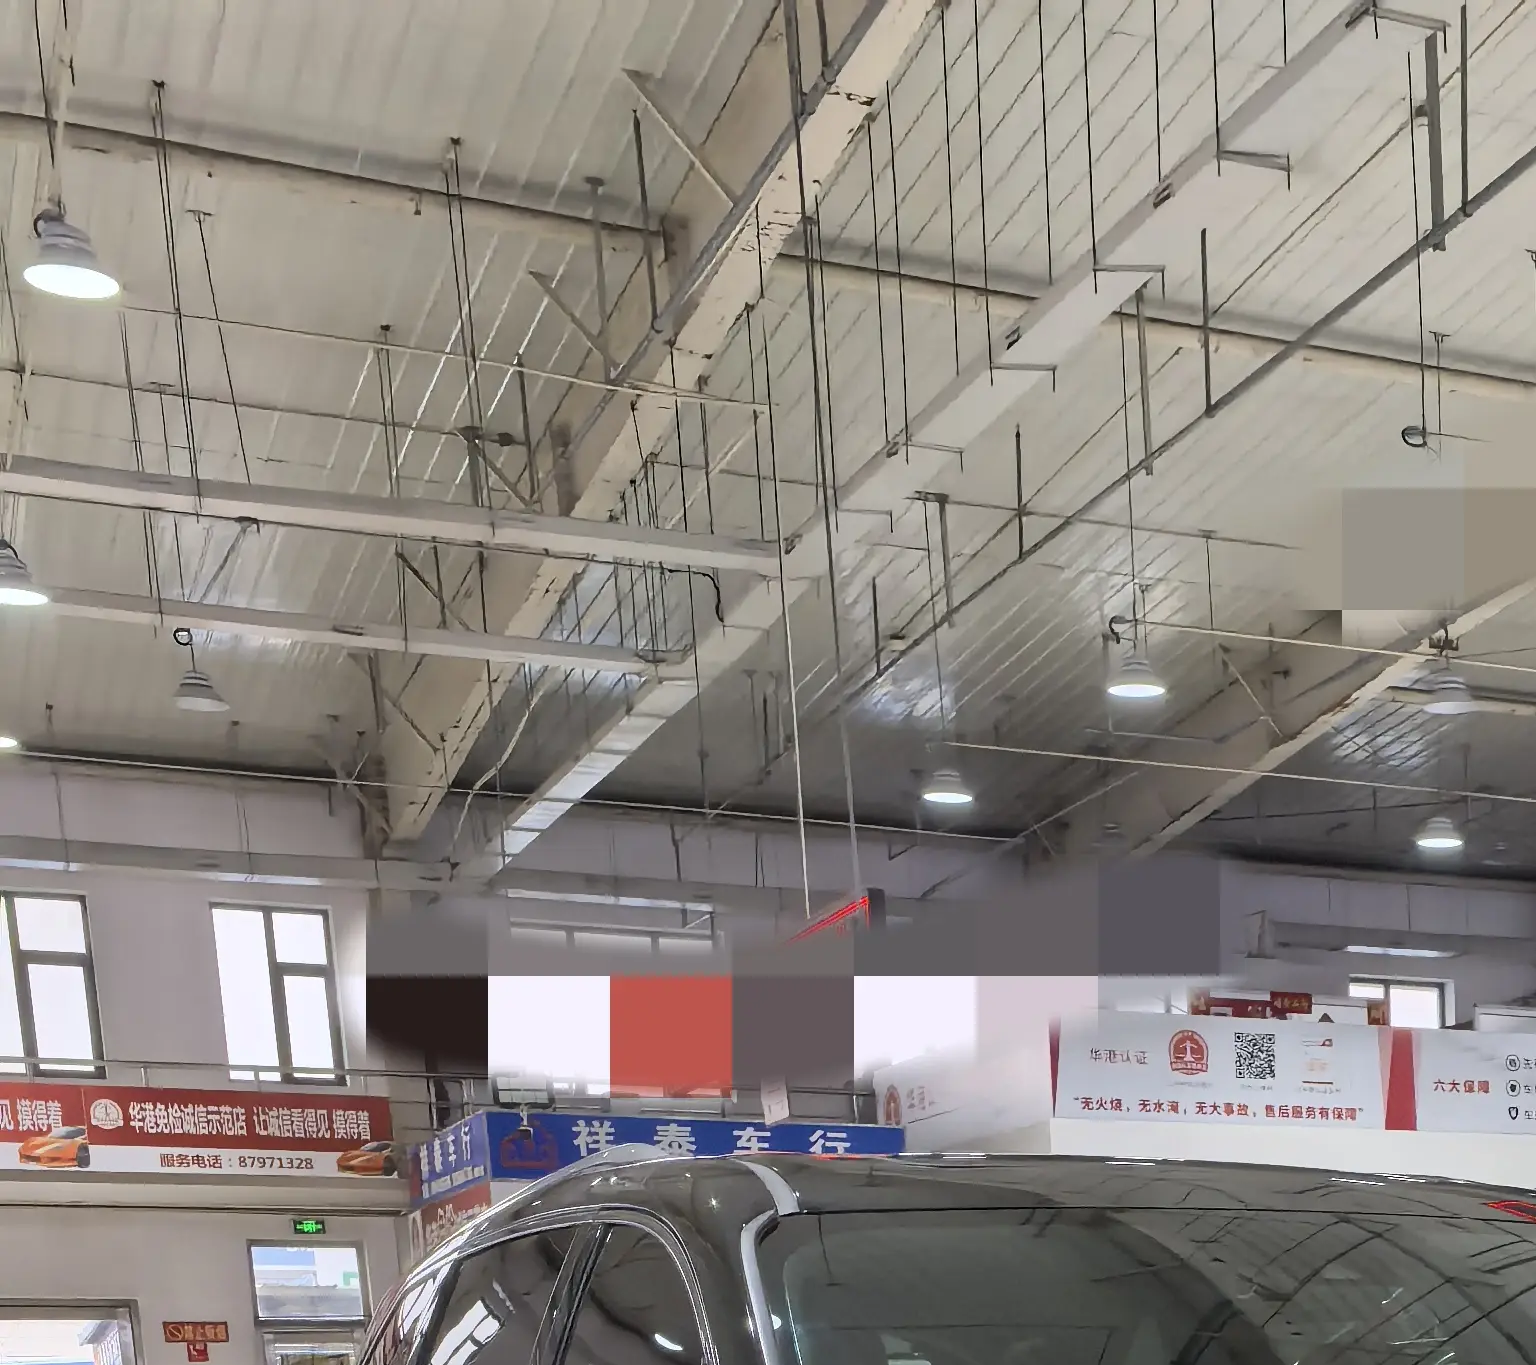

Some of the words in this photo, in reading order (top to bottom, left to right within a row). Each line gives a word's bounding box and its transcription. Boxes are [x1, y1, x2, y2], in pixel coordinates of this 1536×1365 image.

[1433, 1079, 1491, 1095] 六大保障
[16, 1096, 63, 1134] 摸得着
[128, 1101, 248, 1136] 华港免检诚信示范店
[252, 1105, 331, 1139] 让诚信看得见
[332, 1108, 371, 1141] 摸得着
[571, 1118, 851, 1157] 祥泰车行
